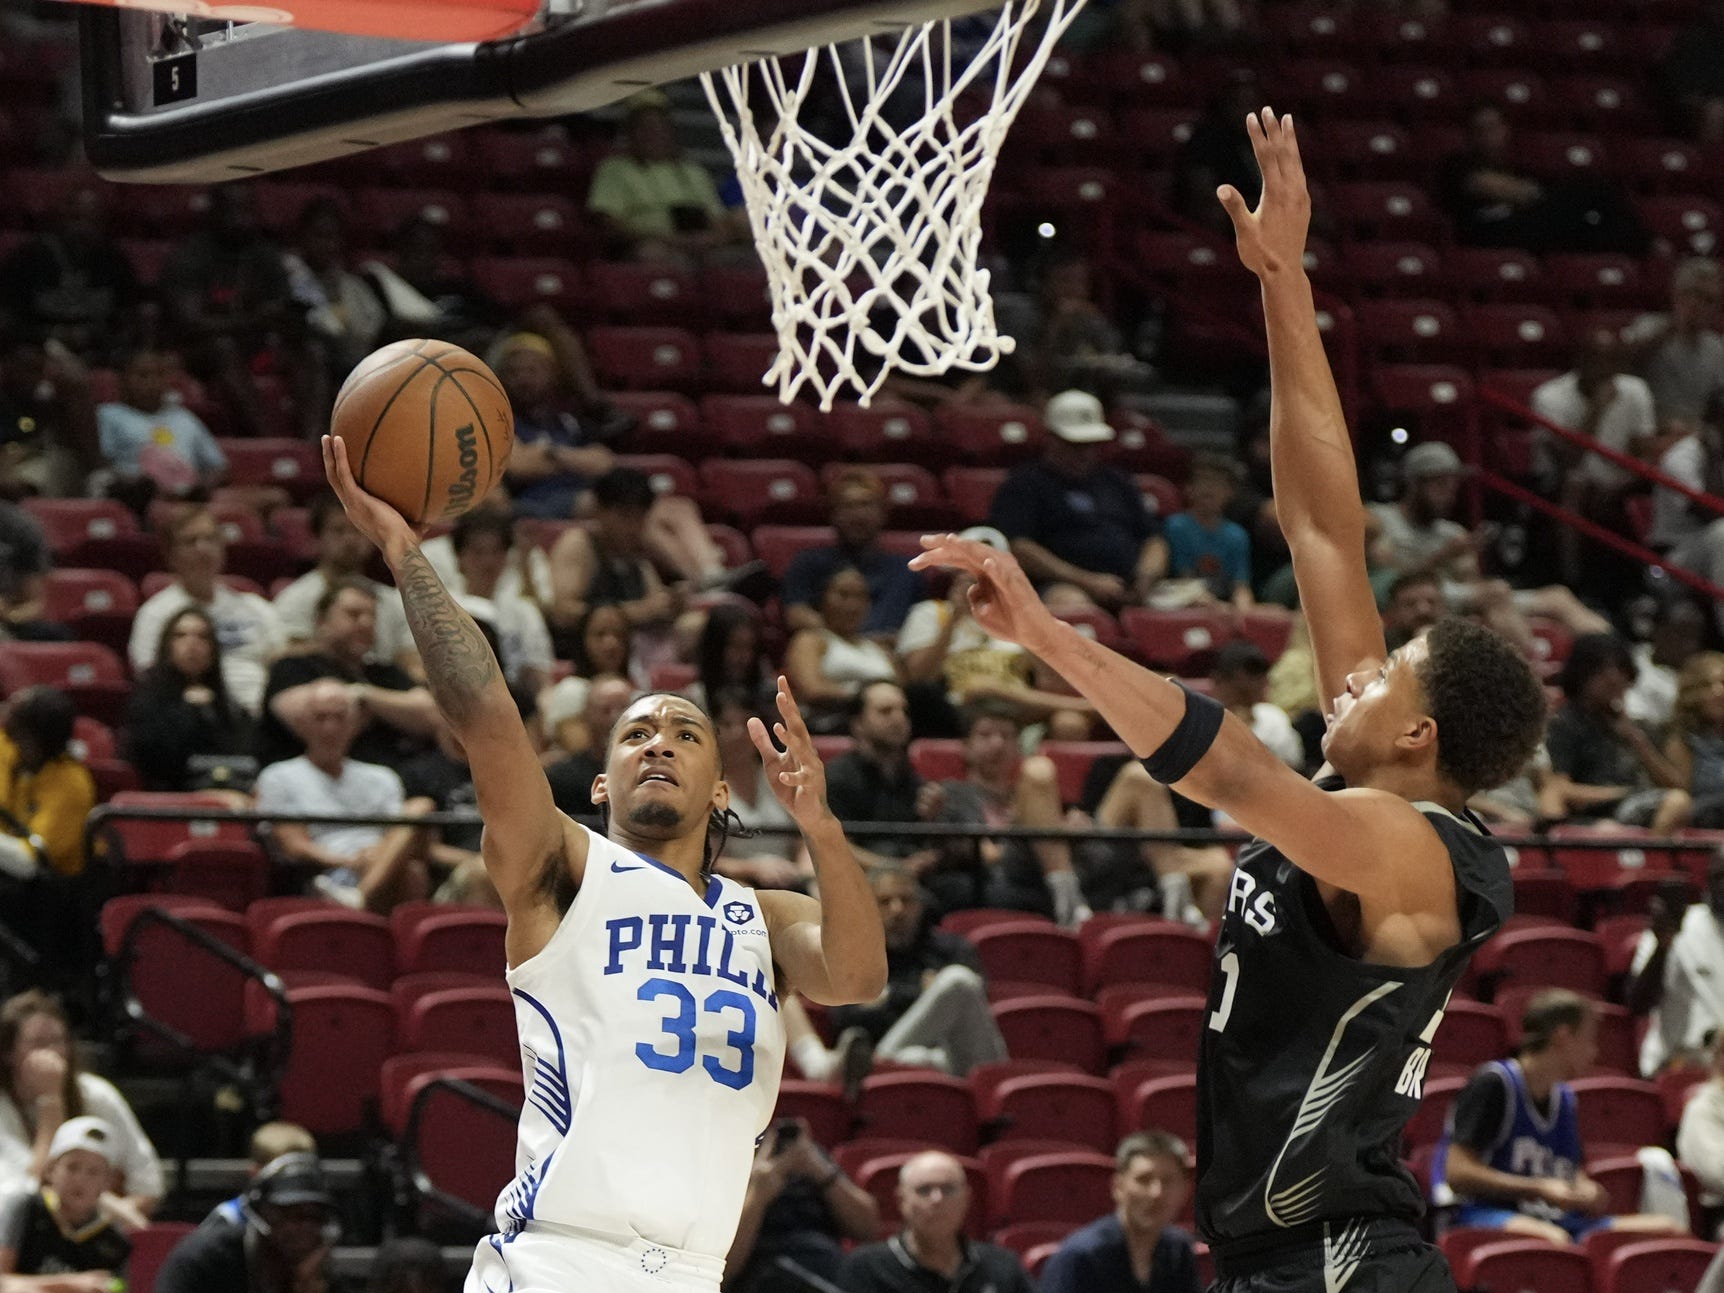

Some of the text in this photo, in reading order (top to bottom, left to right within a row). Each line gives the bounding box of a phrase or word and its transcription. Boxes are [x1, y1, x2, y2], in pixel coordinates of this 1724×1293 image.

[171, 66, 179, 91] 5
[1222, 868, 1276, 936] RS
[635, 978, 756, 1090] 33
